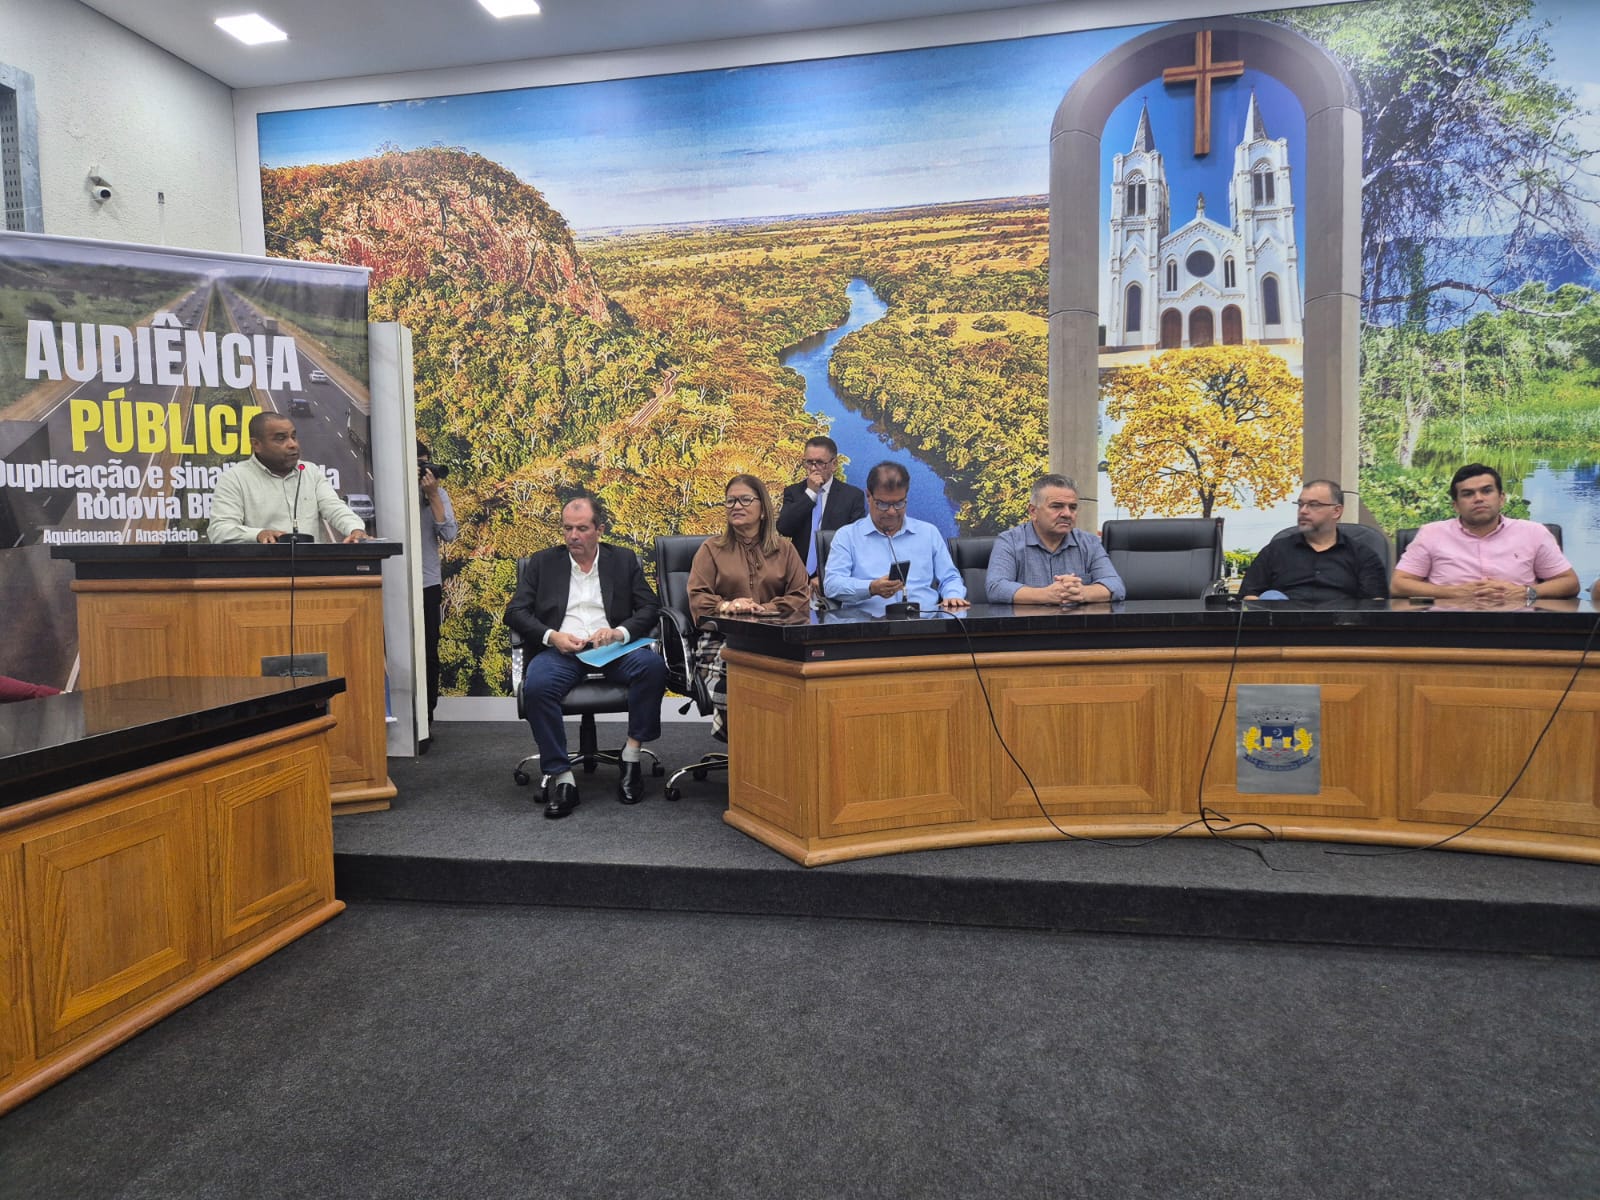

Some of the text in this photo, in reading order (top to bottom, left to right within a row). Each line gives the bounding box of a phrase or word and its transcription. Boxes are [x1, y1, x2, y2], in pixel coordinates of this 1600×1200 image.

[25, 312, 303, 391] AUDIÊNCIA
[148, 465, 164, 488] e
[77, 491, 181, 519] Rodovia
[43, 528, 122, 546] Aquidauana
[136, 527, 198, 543] Anastácio
